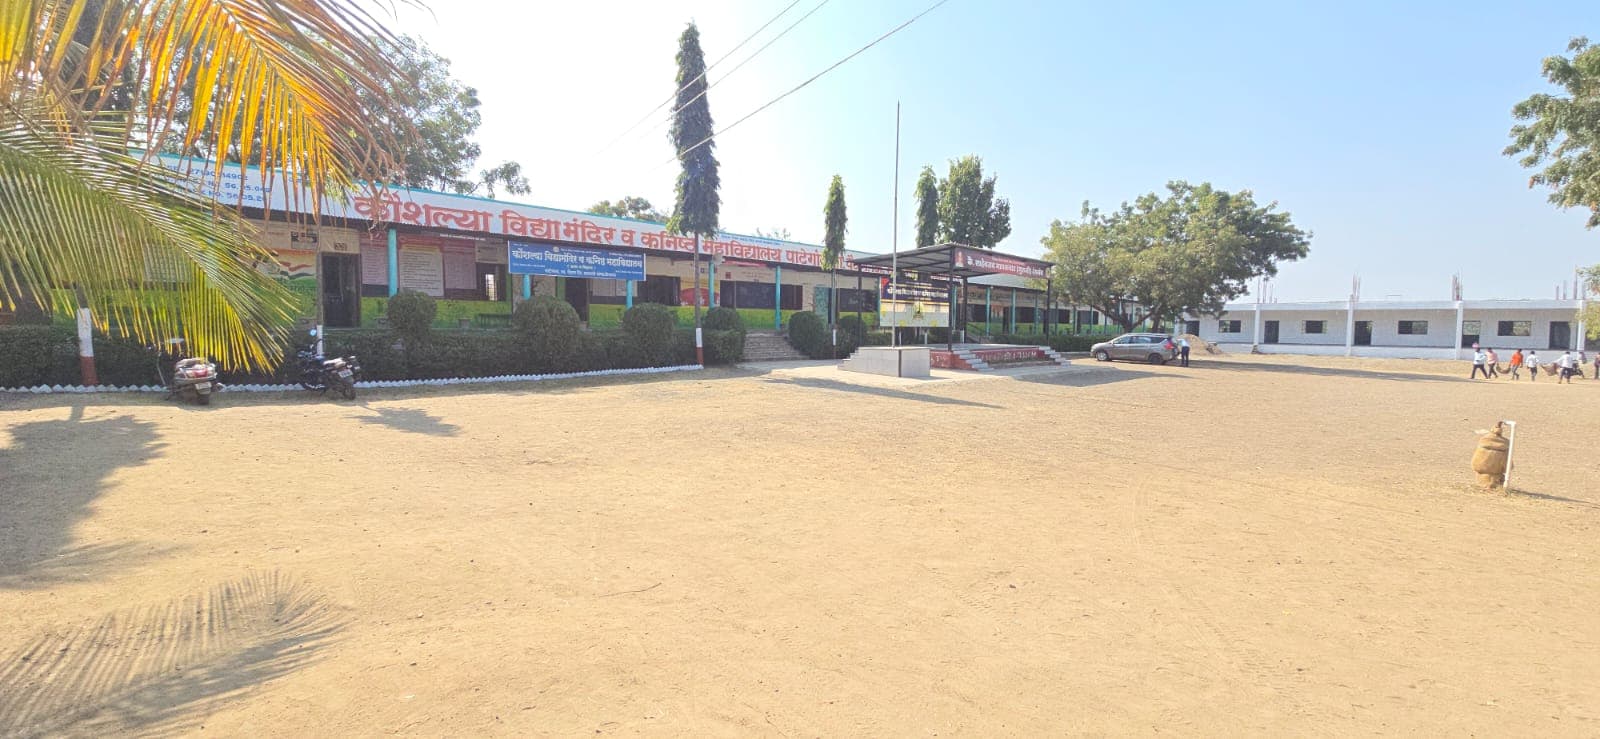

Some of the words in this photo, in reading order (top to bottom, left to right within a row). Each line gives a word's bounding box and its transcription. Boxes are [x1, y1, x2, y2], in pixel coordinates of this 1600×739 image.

[354, 192, 492, 232] कौशल्या
[621, 229, 636, 246] व
[702, 239, 782, 262] महाविद्यालय
